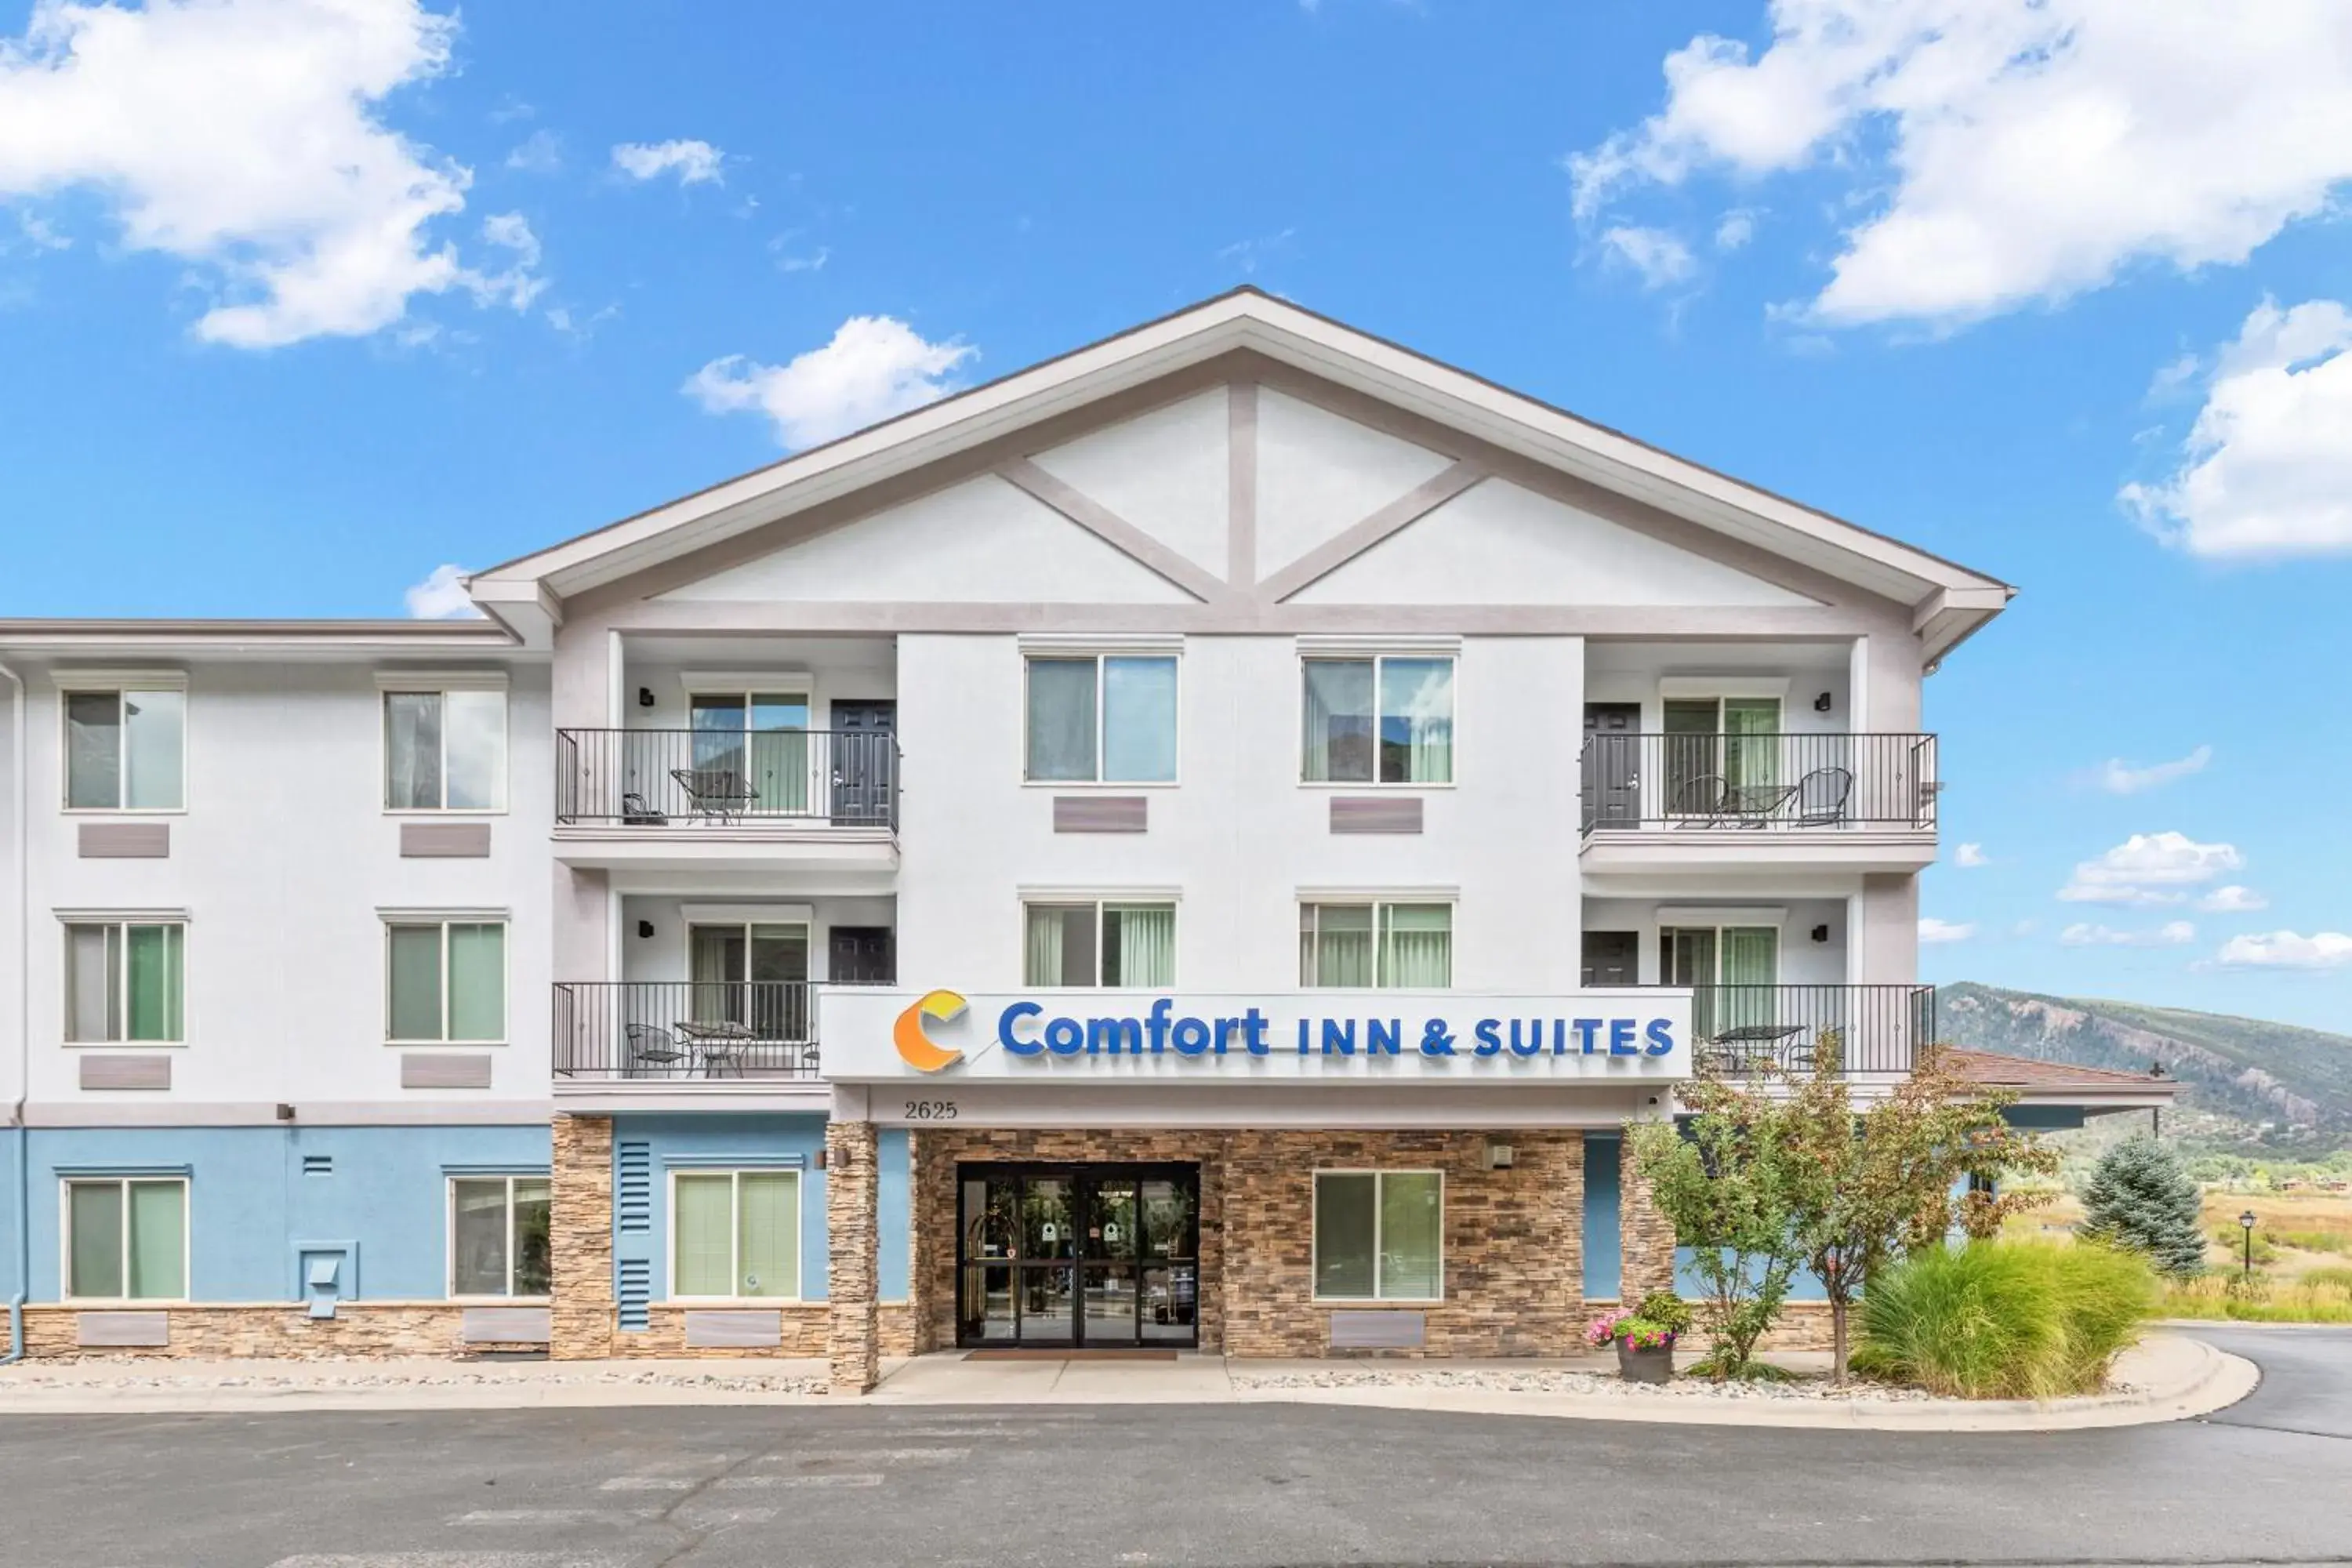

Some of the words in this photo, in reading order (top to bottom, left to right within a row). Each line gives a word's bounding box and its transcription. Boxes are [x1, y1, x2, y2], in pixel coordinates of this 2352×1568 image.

[999, 998, 1269, 1056] Comfort
[1298, 1018, 1401, 1055] INN
[1420, 1018, 1457, 1056] &
[1475, 1018, 1674, 1056] SUITES
[905, 1101, 958, 1120] 2625
